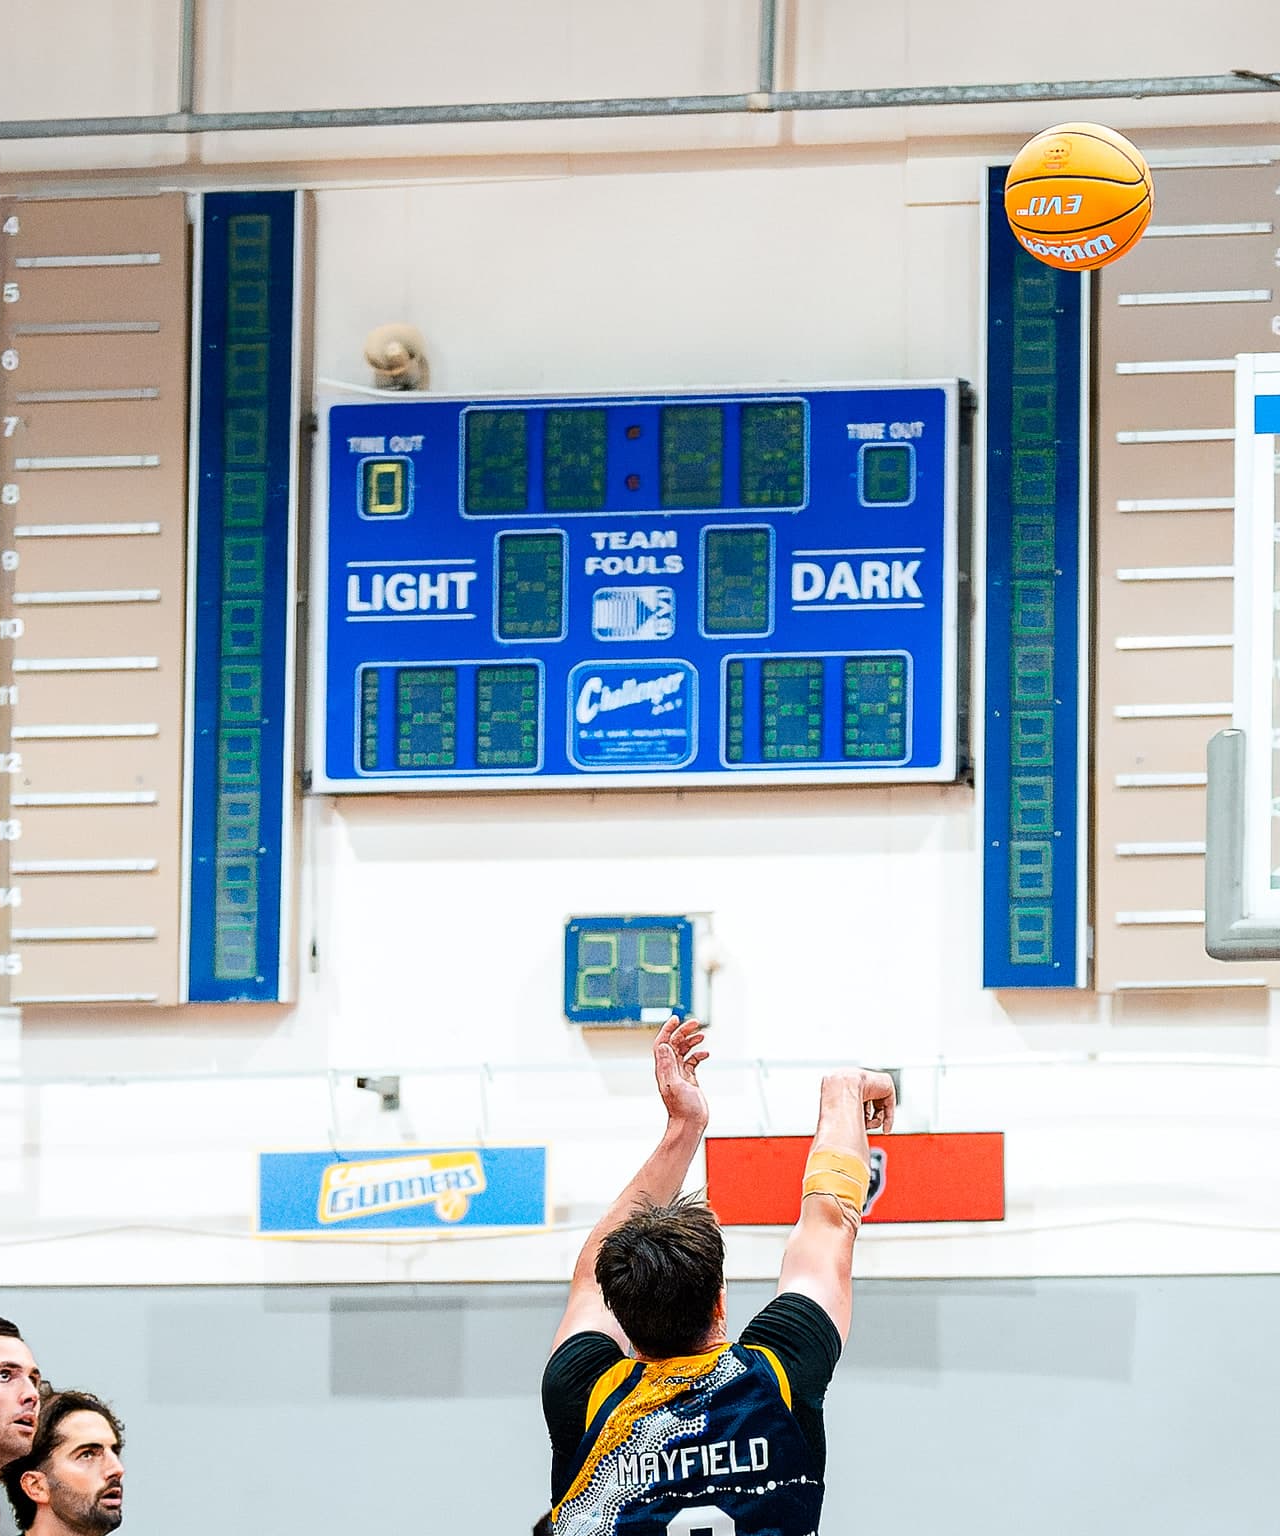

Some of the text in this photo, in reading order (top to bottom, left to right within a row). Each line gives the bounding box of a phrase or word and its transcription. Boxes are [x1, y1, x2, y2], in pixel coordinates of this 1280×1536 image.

[1020, 233, 1117, 263] Wilson
[3, 282, 20, 304] 5
[3, 416, 20, 438] 7
[591, 530, 677, 550] TEAM
[584, 555, 684, 576] FOULS
[791, 560, 923, 601] DARK
[346, 571, 477, 612] LIGHT
[0, 617, 24, 641] 10
[577, 932, 678, 1009] 24
[329, 1167, 476, 1215] GUNNERS
[617, 1436, 770, 1486] MAYFIELD
